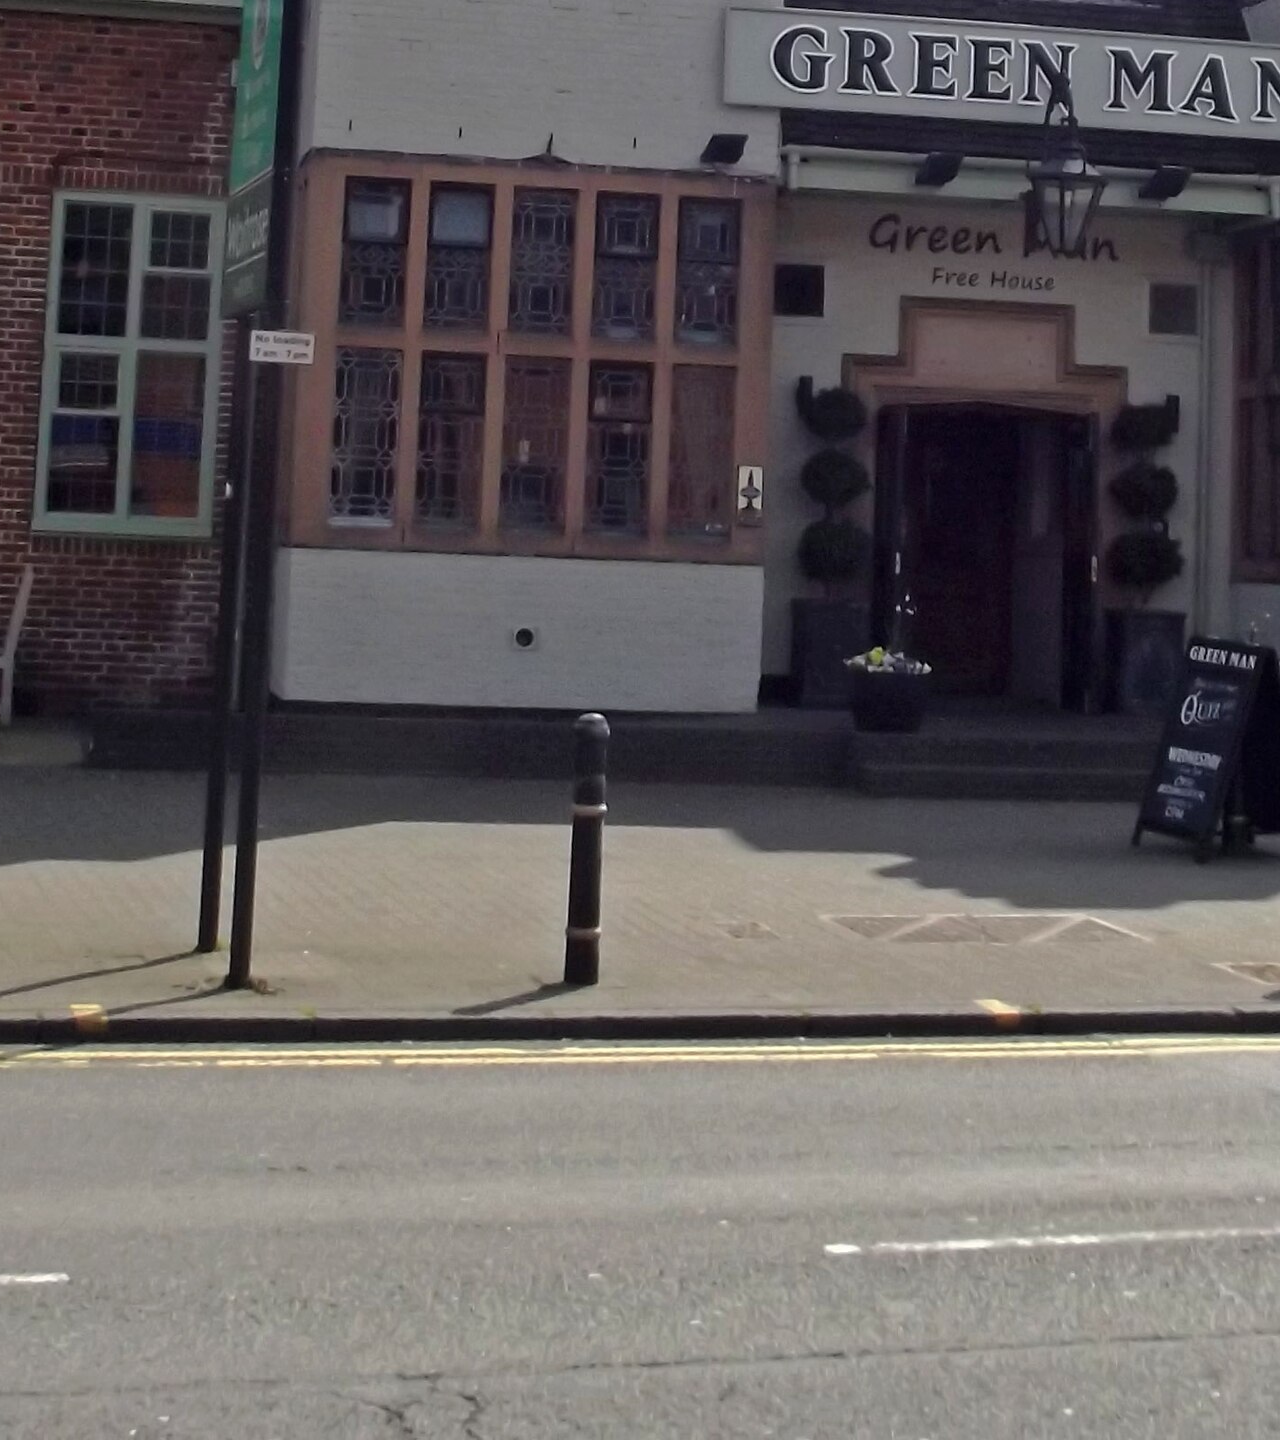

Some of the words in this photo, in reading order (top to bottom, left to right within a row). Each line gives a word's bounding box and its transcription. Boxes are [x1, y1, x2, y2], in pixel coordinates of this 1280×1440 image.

[770, 24, 1080, 113] GREEN
[869, 213, 1002, 255] Green
[931, 266, 981, 288] Free
[990, 270, 1056, 291] House
[255, 335, 270, 343] No
[1189, 645, 1228, 665] GREEN
[1228, 651, 1257, 670] MAN
